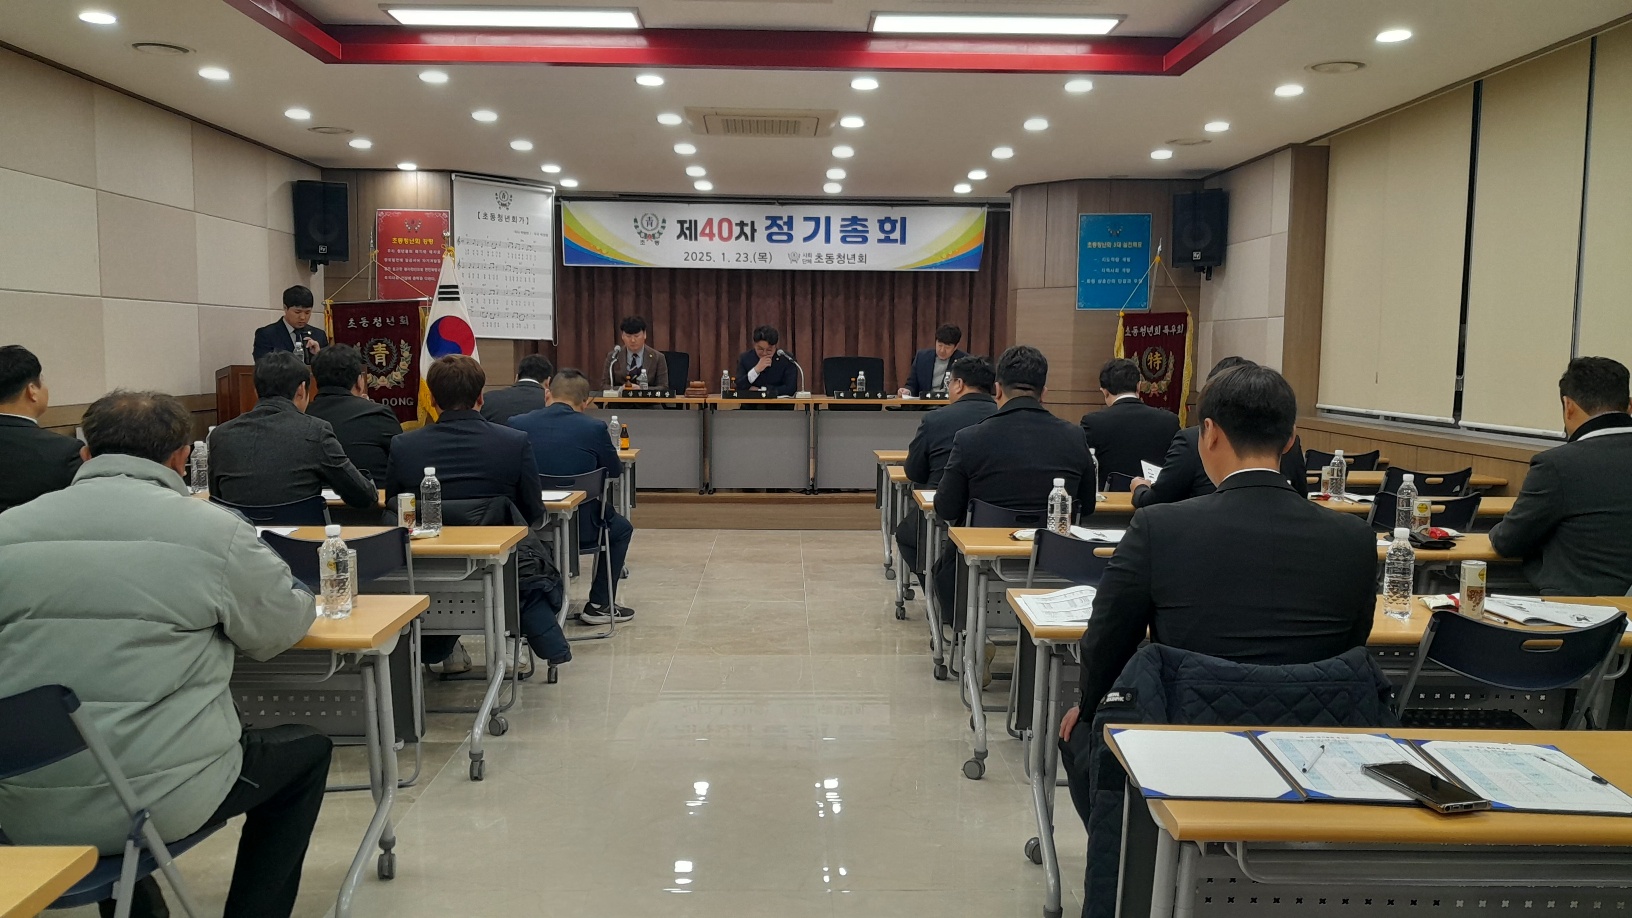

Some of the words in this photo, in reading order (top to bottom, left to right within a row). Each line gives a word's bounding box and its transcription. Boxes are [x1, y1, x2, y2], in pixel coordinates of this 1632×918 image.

[676, 217, 757, 243] 제40차
[764, 215, 907, 246] 정기총회
[683, 251, 716, 263] 2025.
[814, 252, 867, 265] 초동청년회
[347, 315, 409, 328] 초동청년회
[1125, 325, 1161, 337] 초동청년회
[369, 342, 390, 367] 青
[1147, 351, 1163, 371] 特
